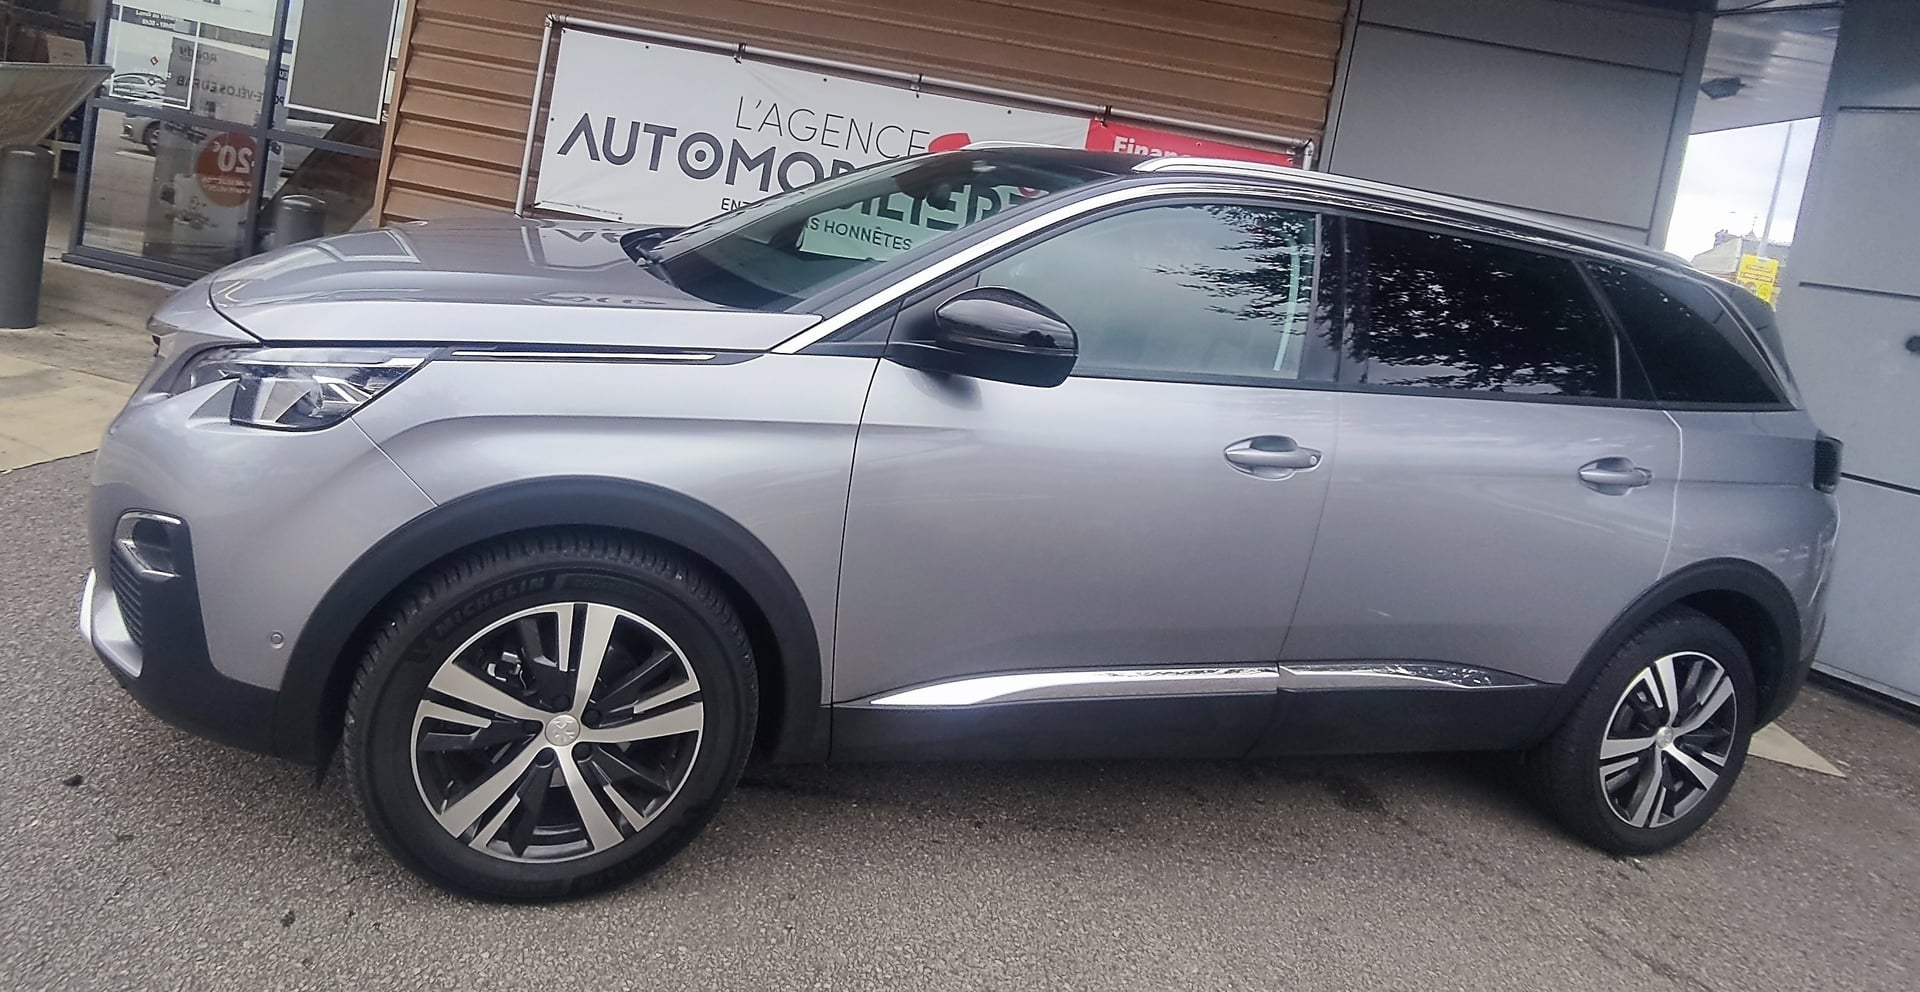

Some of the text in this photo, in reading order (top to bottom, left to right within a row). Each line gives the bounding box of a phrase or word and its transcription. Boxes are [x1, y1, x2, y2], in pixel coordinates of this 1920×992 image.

[735, 96, 930, 159] L'AGENCE
[824, 220, 912, 250] HONNÊTES
[435, 575, 545, 637] MICHELIN
